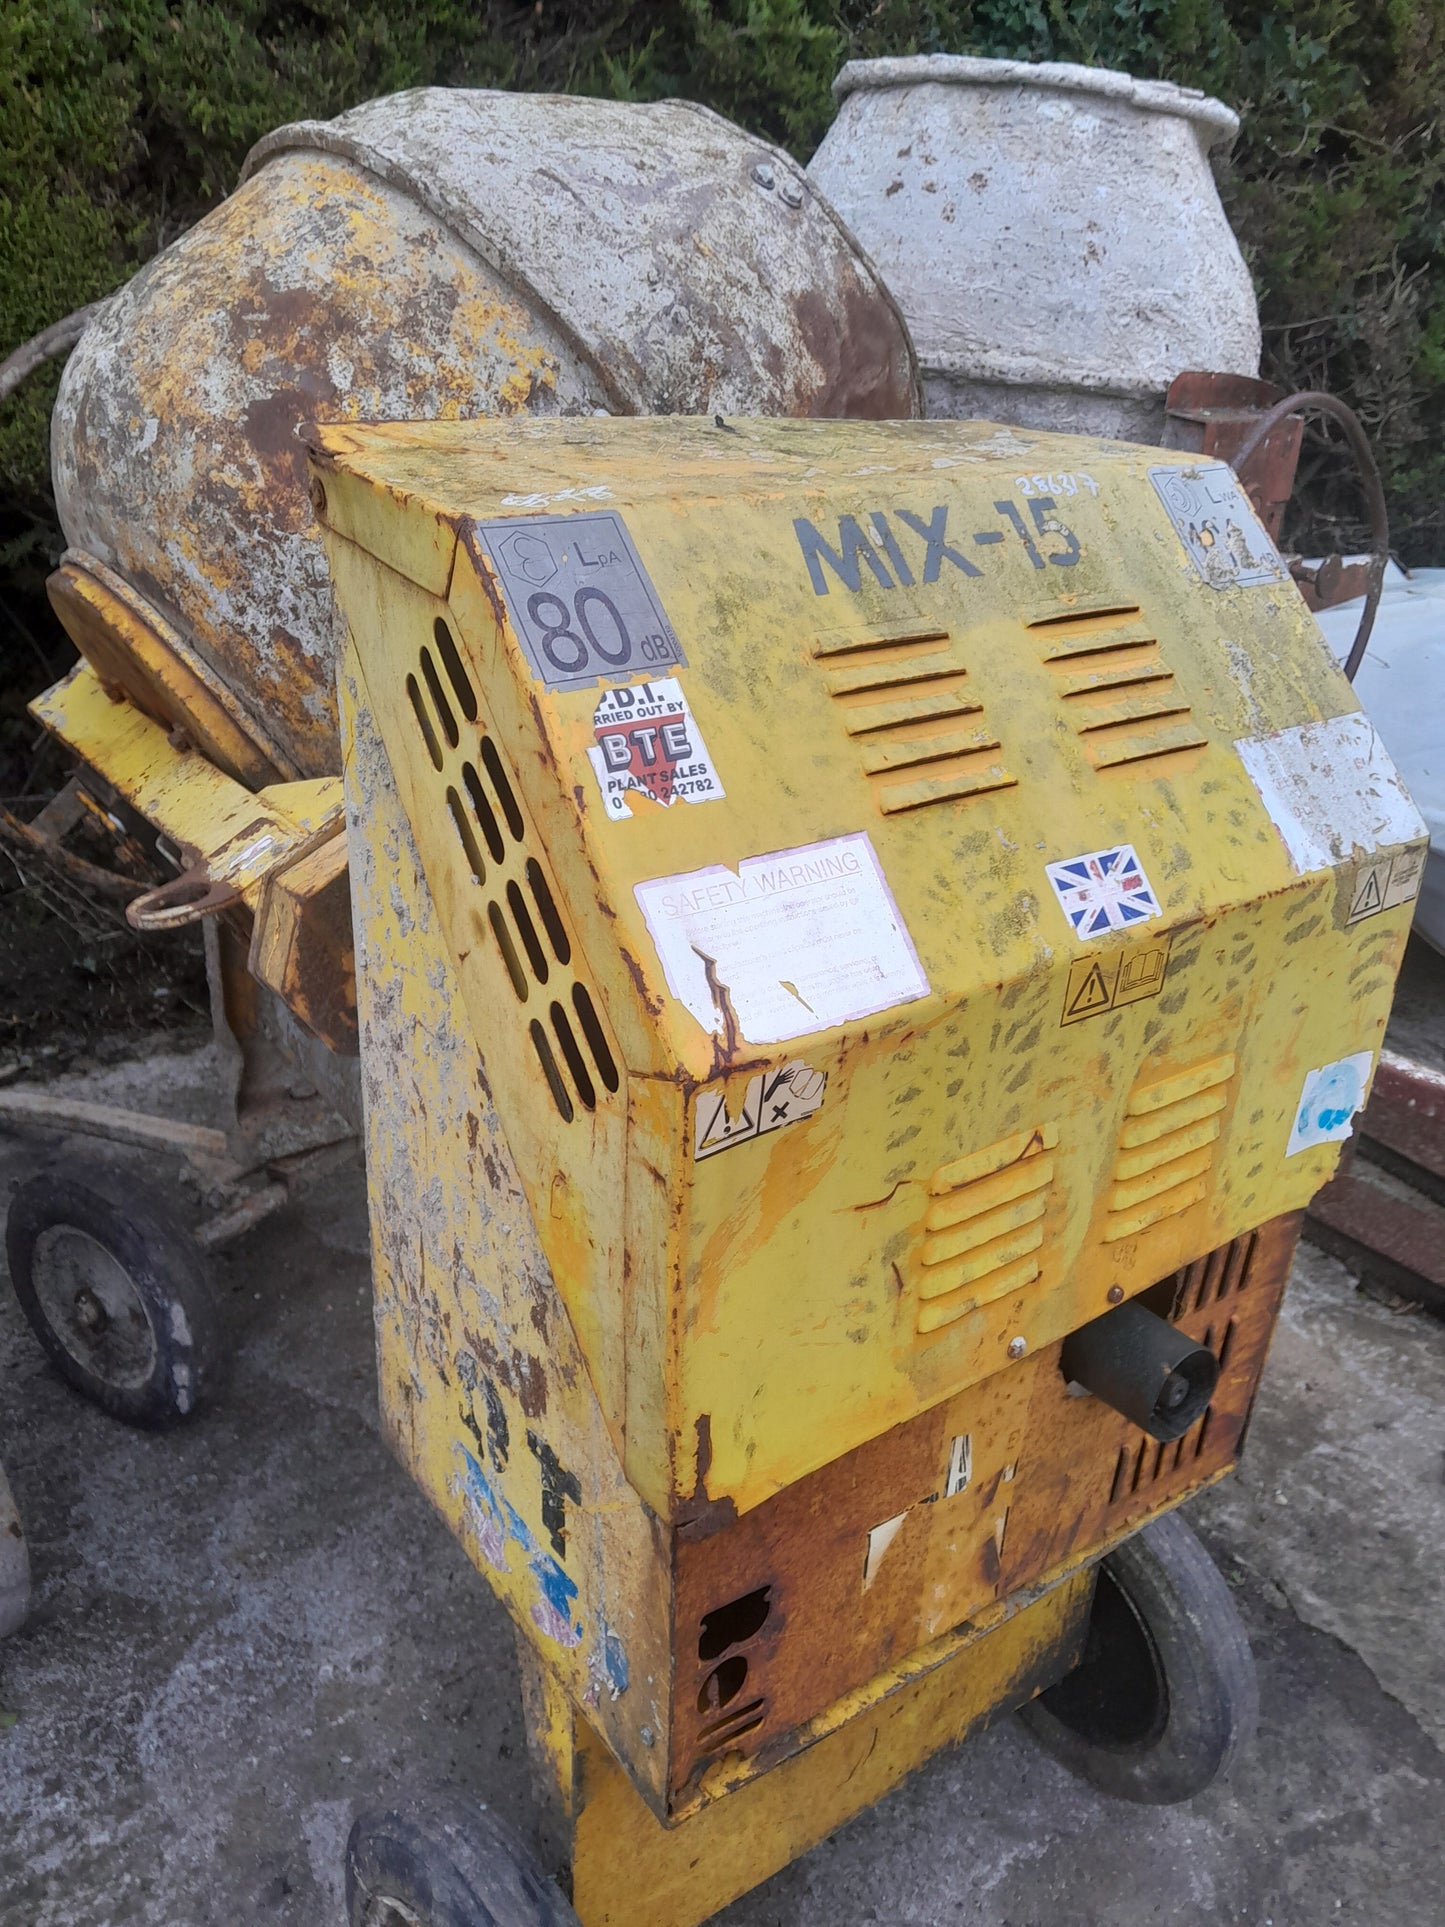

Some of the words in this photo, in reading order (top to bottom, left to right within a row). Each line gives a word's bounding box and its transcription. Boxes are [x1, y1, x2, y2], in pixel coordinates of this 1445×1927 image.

[793, 497, 1082, 596] MIX-15
[526, 586, 632, 674] 80
[640, 633, 669, 662] dB
[636, 704, 664, 718] OUT
[668, 700, 685, 713] BY
[598, 720, 693, 774] BTE
[607, 772, 658, 794] PLANT
[659, 763, 708, 783] SALES
[660, 777, 715, 800] 242782
[662, 879, 747, 917] SAFETY
[753, 851, 860, 893] WARNING
